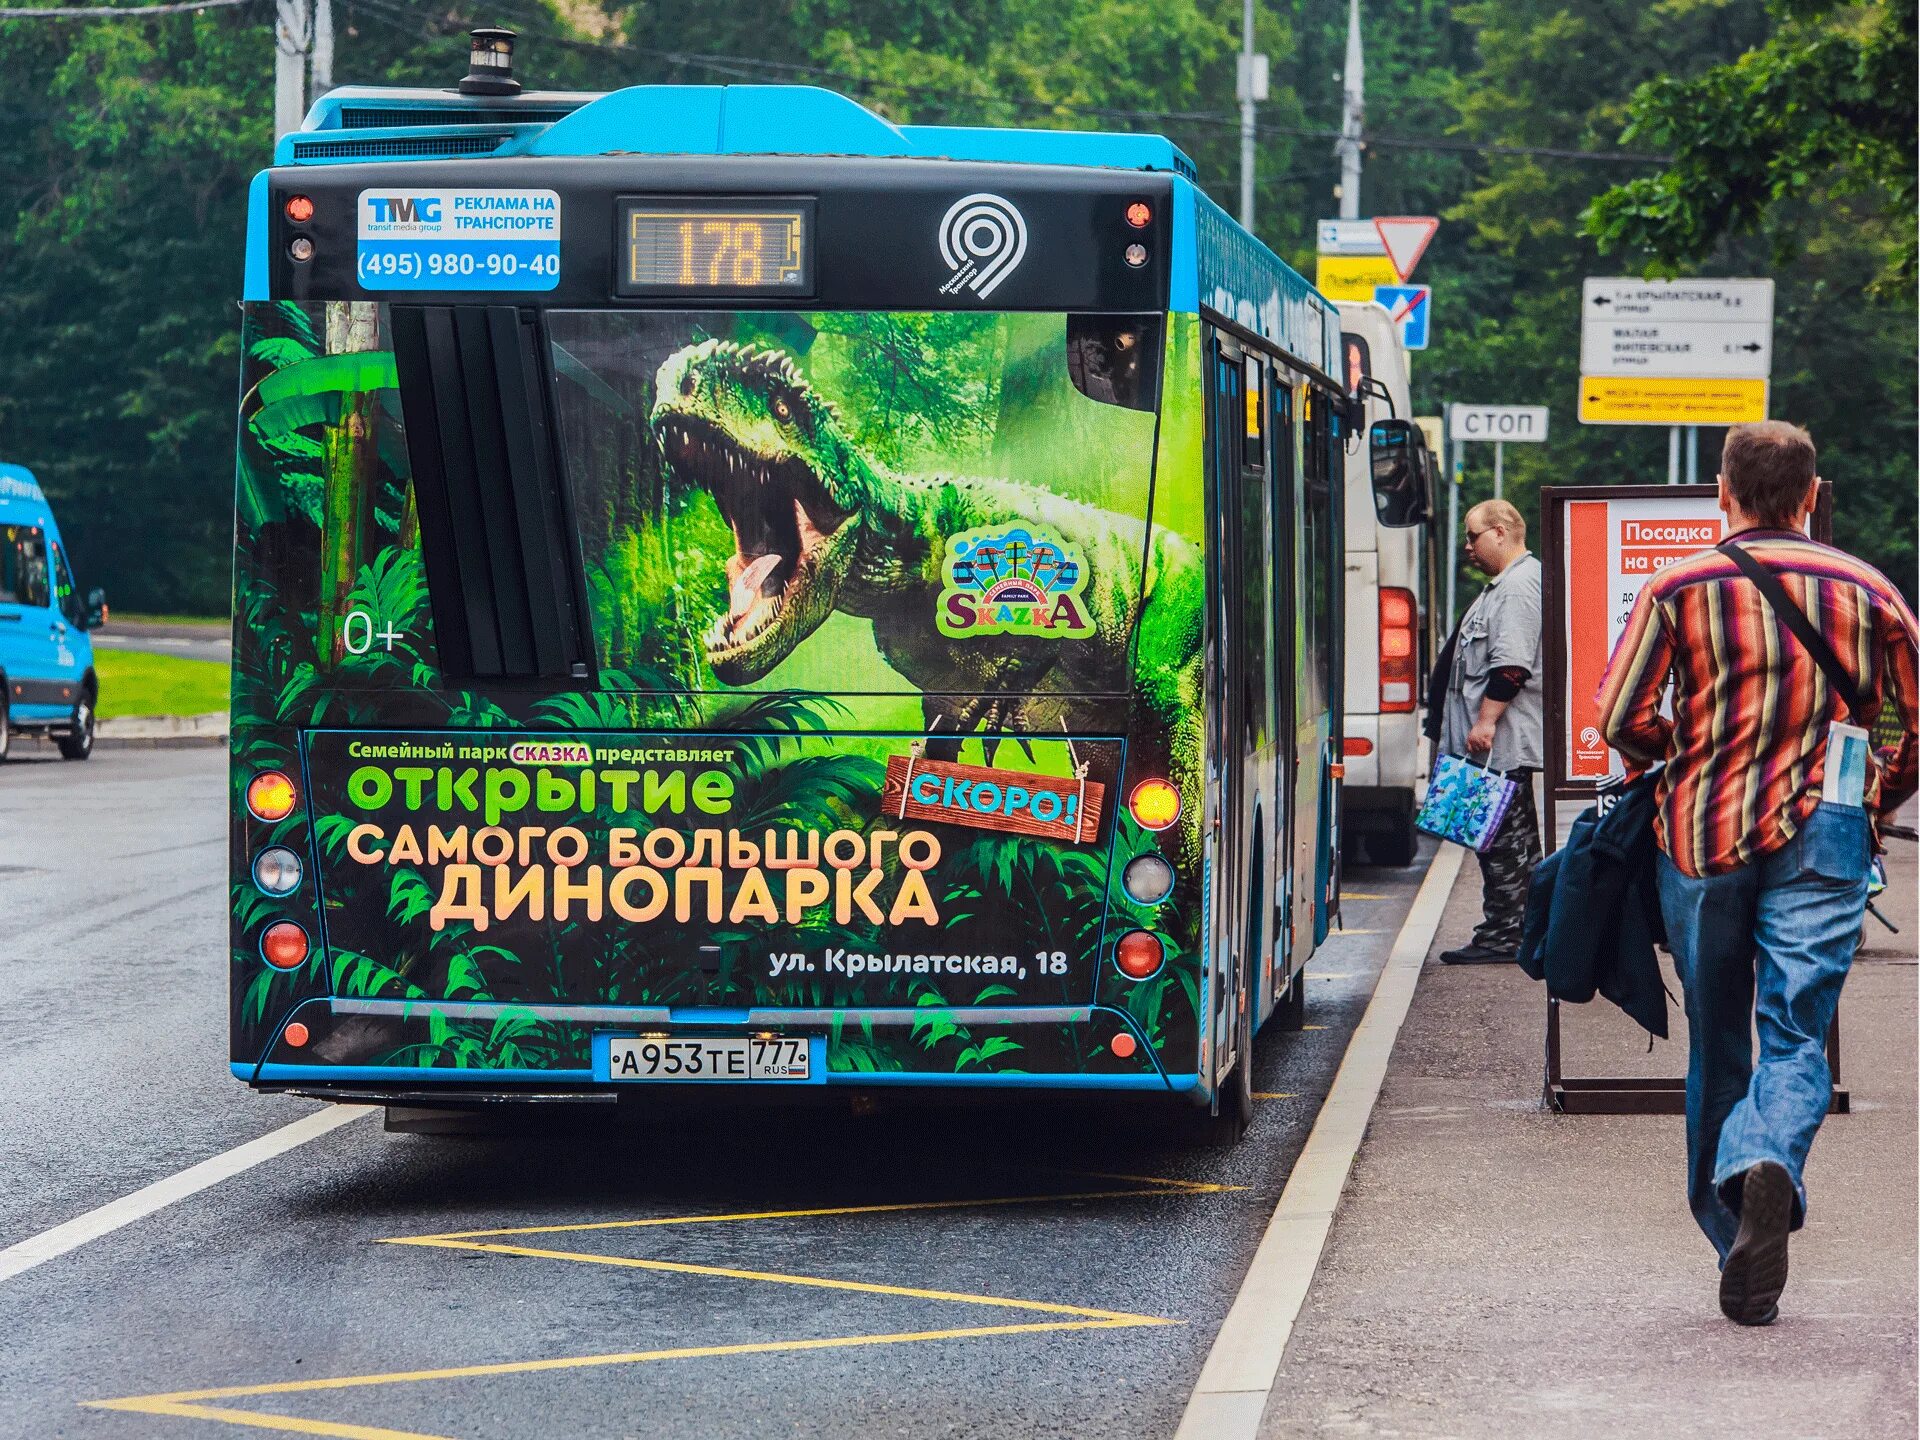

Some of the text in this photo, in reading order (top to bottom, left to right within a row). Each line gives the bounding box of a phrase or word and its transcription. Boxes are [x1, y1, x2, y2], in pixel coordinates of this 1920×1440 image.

[367, 198, 442, 222] TMG
[454, 197, 556, 210] РЕКЛАМА НА
[367, 223, 442, 233] transit media group
[454, 216, 554, 230] ТРАНСПОРТЕ
[358, 252, 560, 279] (495) 980-90-40
[679, 222, 762, 285] 178
[939, 258, 975, 295] Московский
[1465, 413, 1532, 434] СТОП
[1626, 522, 1713, 543] Посадка
[1624, 557, 1648, 569] на
[1622, 592, 1634, 604] до
[945, 593, 1087, 630] SKAZKA
[343, 611, 404, 654] 0+
[348, 741, 735, 766] Семейный парк СКАЗКА представляет
[347, 765, 736, 828] открытие
[911, 772, 1079, 826] СКОРО!
[346, 824, 943, 871] САМОГО БОЛЬШОГО
[429, 863, 940, 932] ДИНОПАРКА
[769, 947, 1068, 980] ул. Крылатская, 18
[752, 1041, 800, 1065] 777
[764, 1065, 788, 1075] RUS
